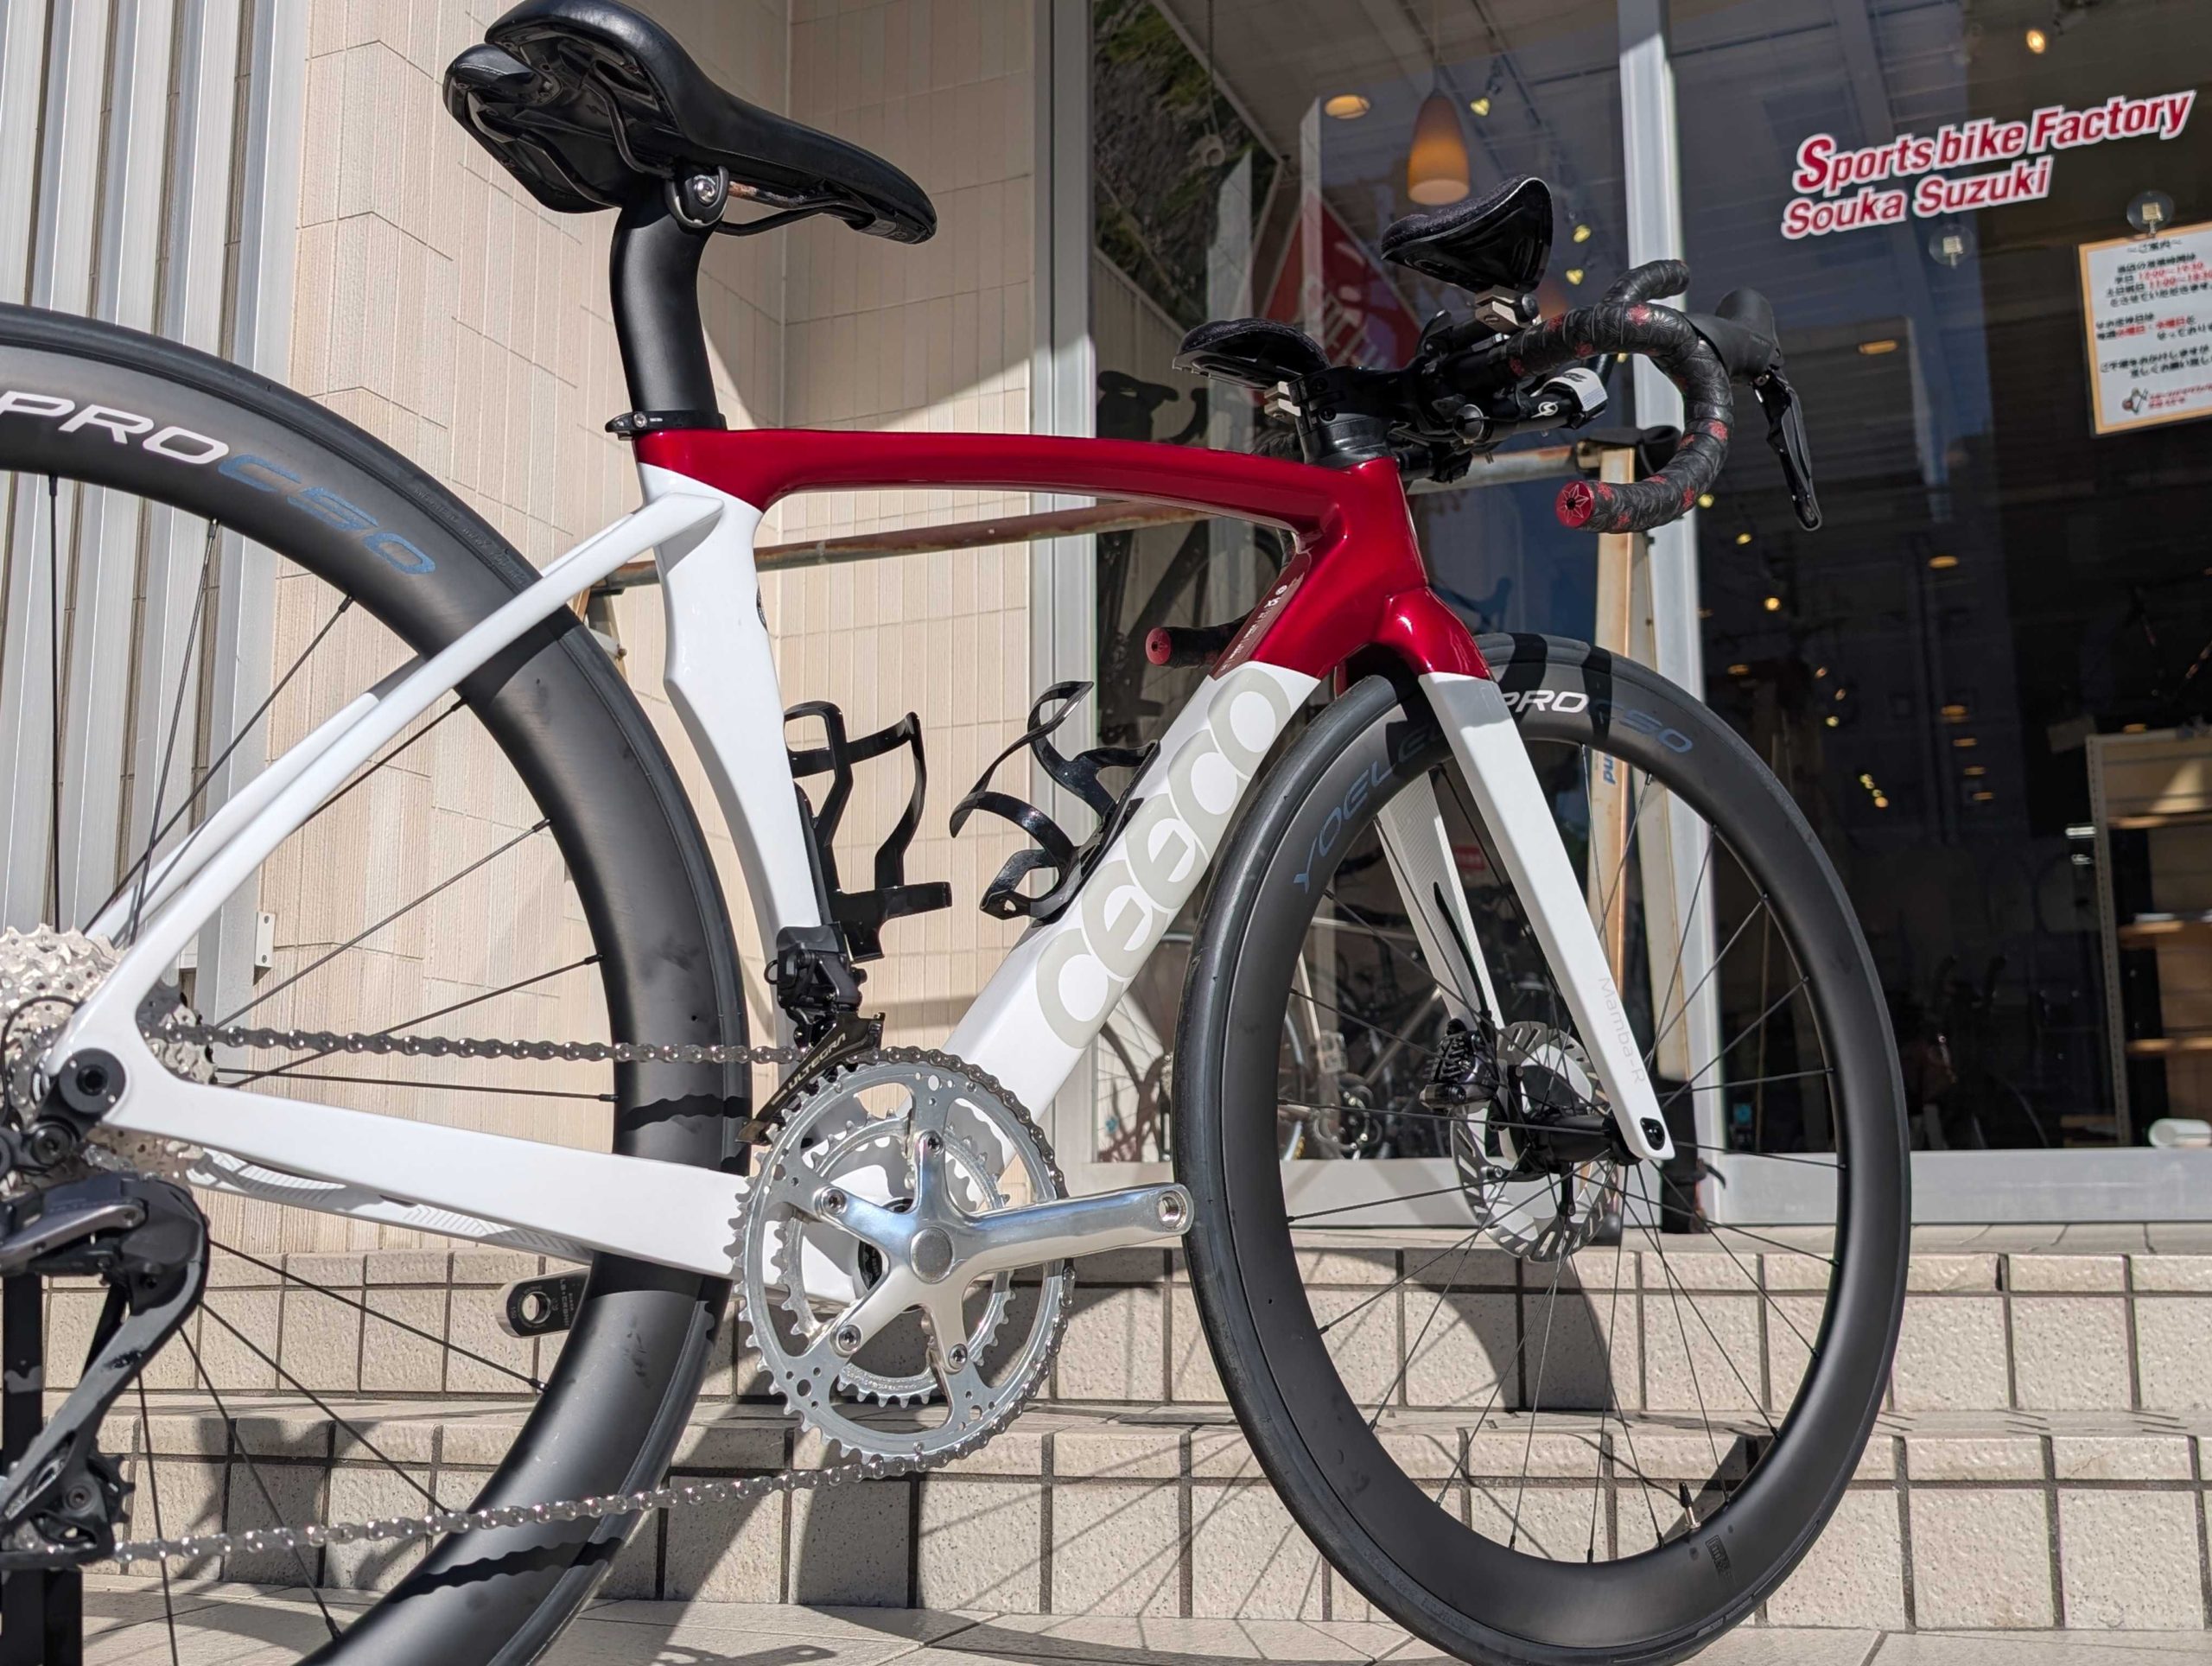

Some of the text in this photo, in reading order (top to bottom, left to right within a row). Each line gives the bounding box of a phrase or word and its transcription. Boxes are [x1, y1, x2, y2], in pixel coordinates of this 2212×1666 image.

[2027, 90, 2196, 154] Factory
[1781, 155, 2054, 239] Souka Suzuki
[0, 391, 229, 465] PRO
[788, 1033, 846, 1090] ULTEGRA
[1598, 976, 1646, 1084] Mamba-R
